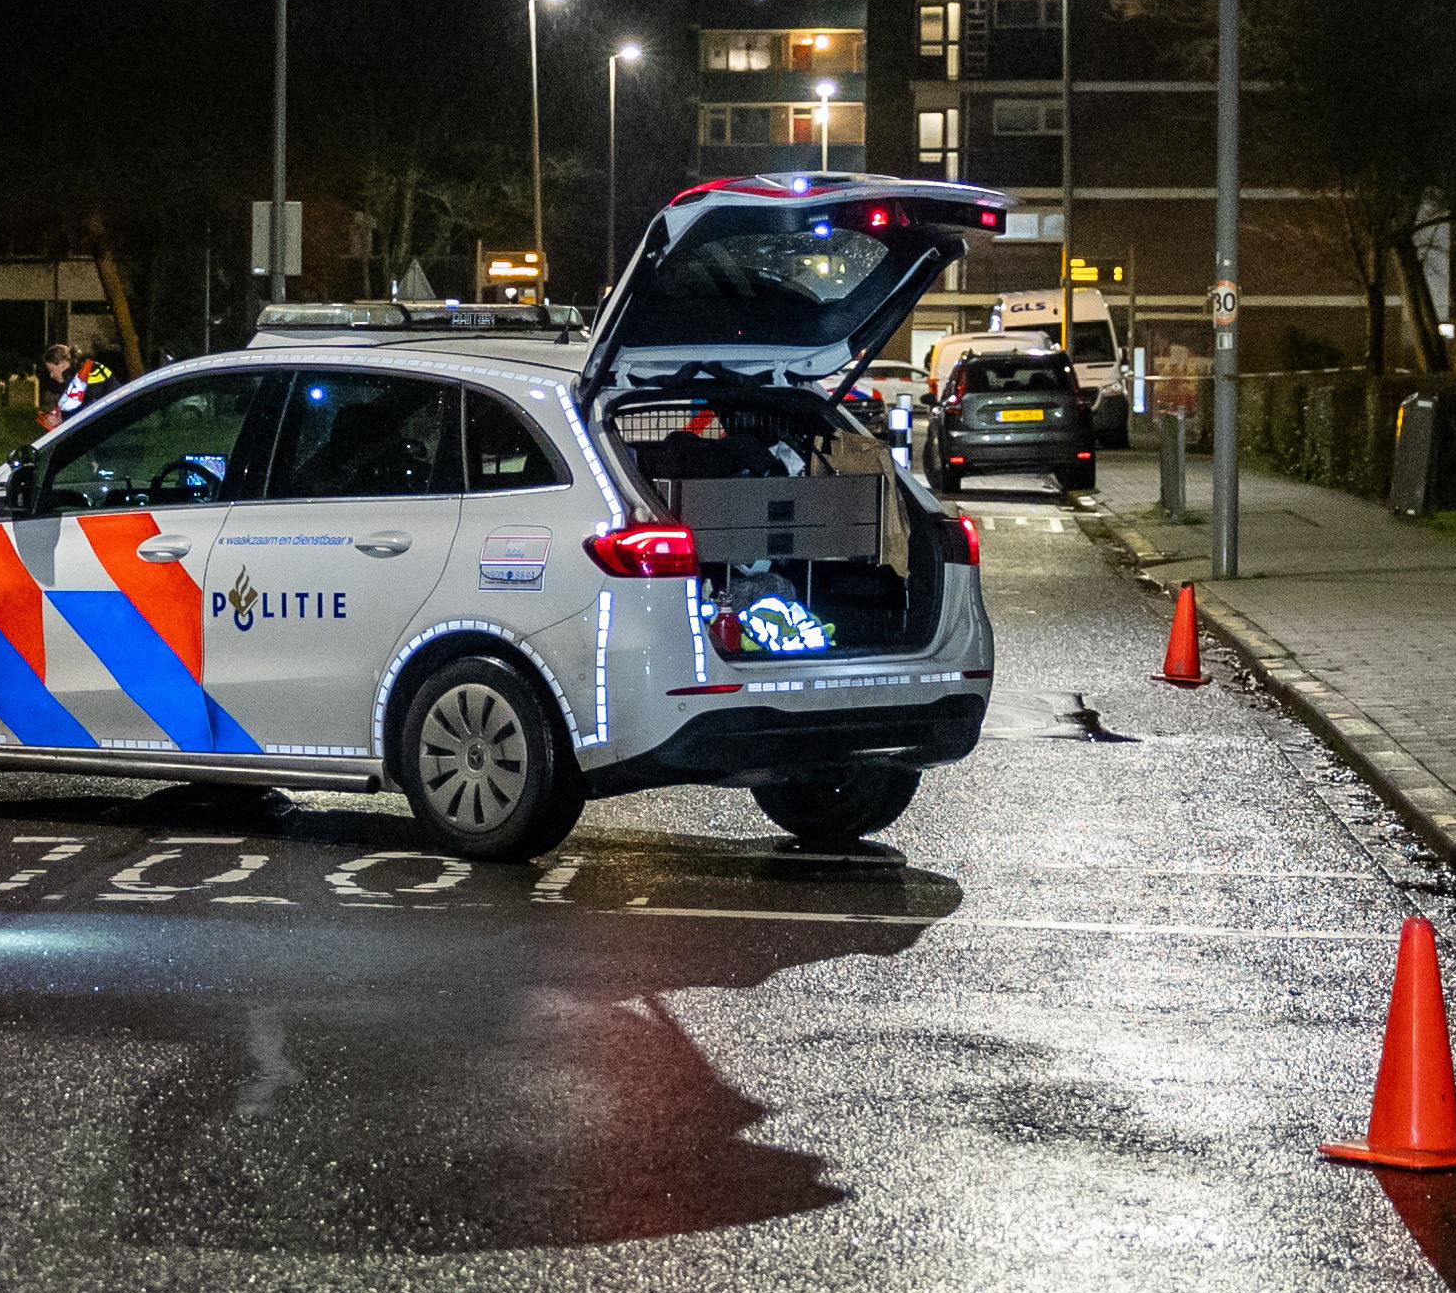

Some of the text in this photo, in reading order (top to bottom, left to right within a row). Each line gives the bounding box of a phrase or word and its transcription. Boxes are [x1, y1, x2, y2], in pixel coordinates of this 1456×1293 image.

[1010, 301, 1046, 313] GLS
[1212, 292, 1236, 312] 30
[226, 535, 277, 546] waakzaam
[279, 537, 291, 545] en
[293, 534, 346, 546] dienstbaar
[212, 591, 347, 632] POLITIE
